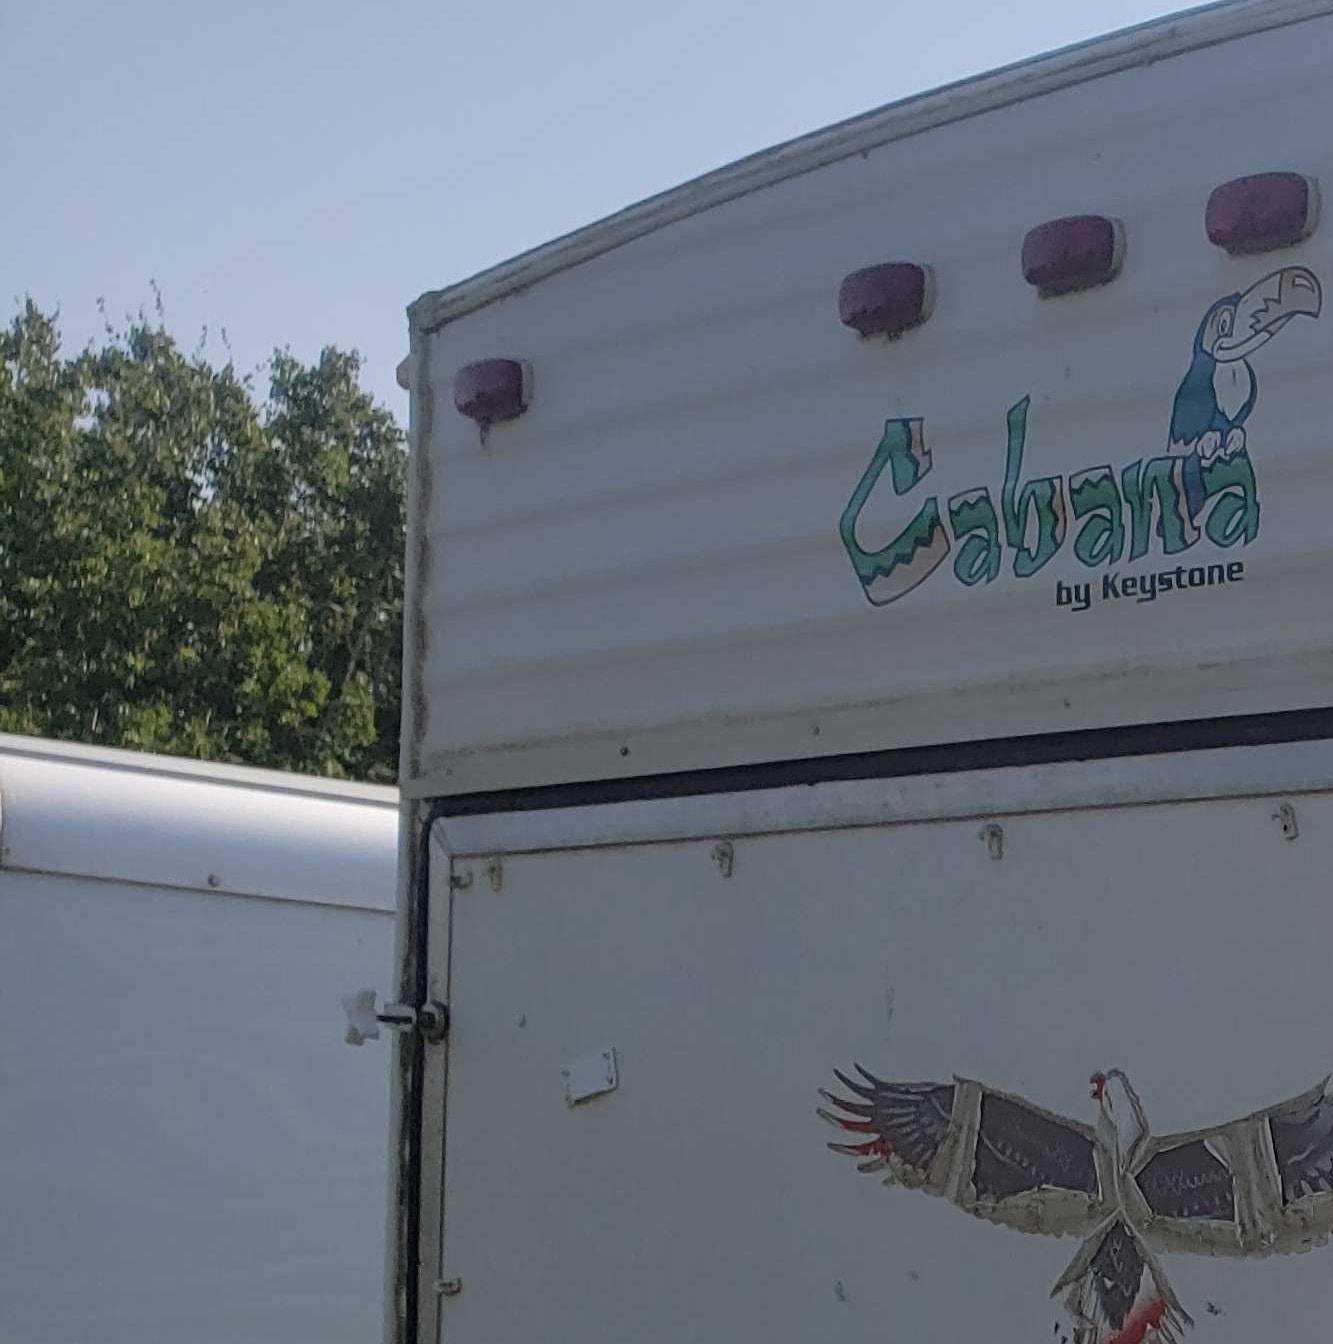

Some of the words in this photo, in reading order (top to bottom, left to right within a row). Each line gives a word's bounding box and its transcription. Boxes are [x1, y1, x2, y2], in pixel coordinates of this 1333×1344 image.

[839, 394, 1260, 607] Cabana
[1056, 580, 1092, 612] by
[1102, 559, 1244, 605] Keystone
